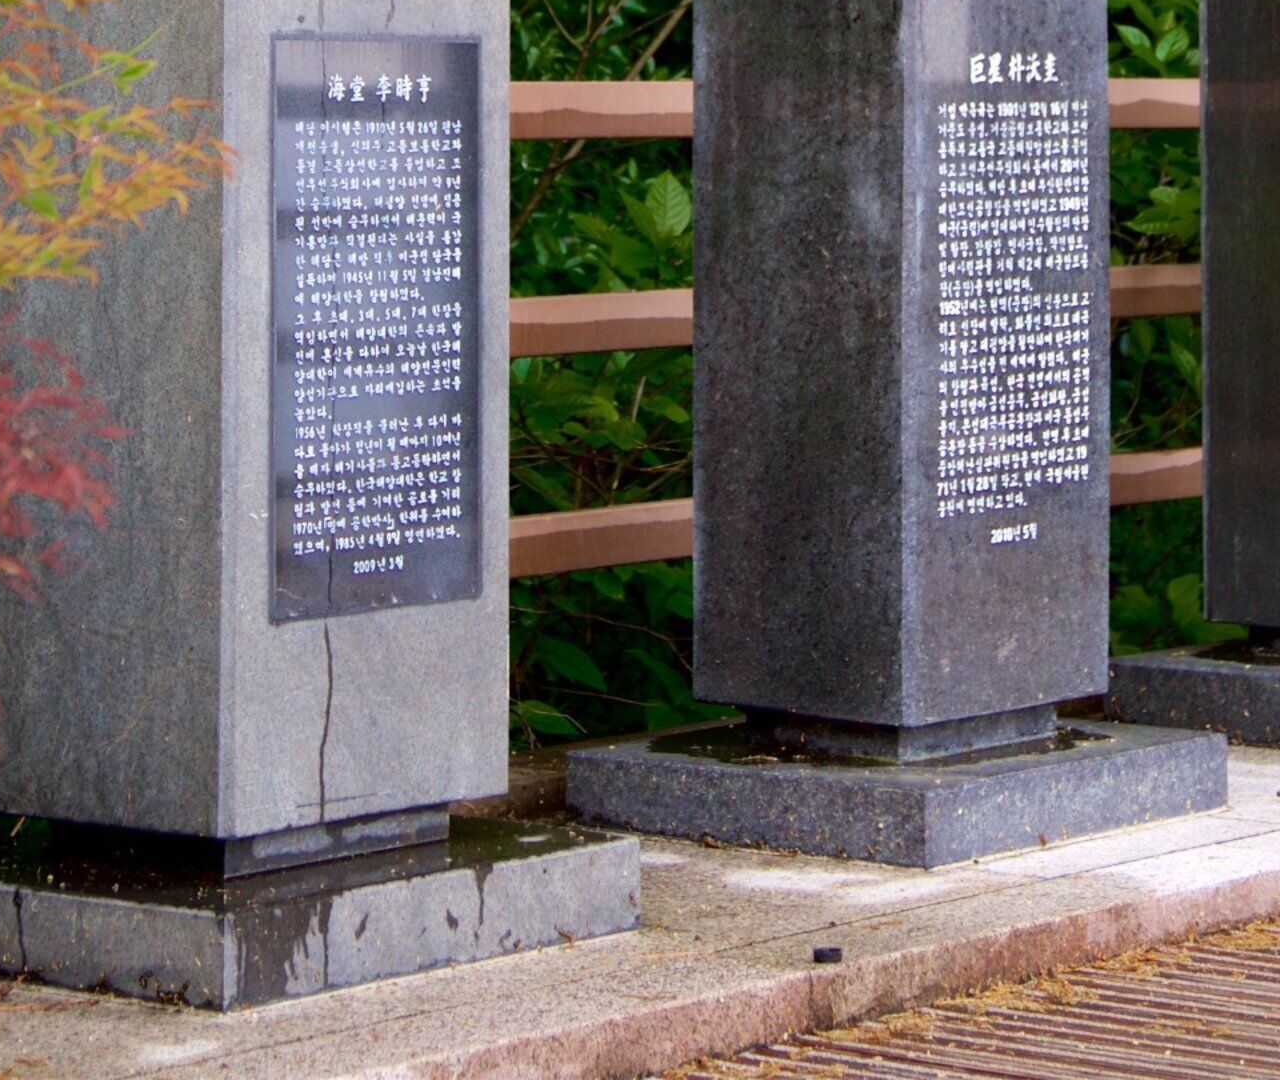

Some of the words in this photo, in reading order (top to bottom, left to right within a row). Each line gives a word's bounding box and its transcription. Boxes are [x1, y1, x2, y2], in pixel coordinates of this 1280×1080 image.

[970, 53, 1003, 84] 巨星
[328, 74, 366, 103] 海堂
[376, 74, 432, 103] 李時亨
